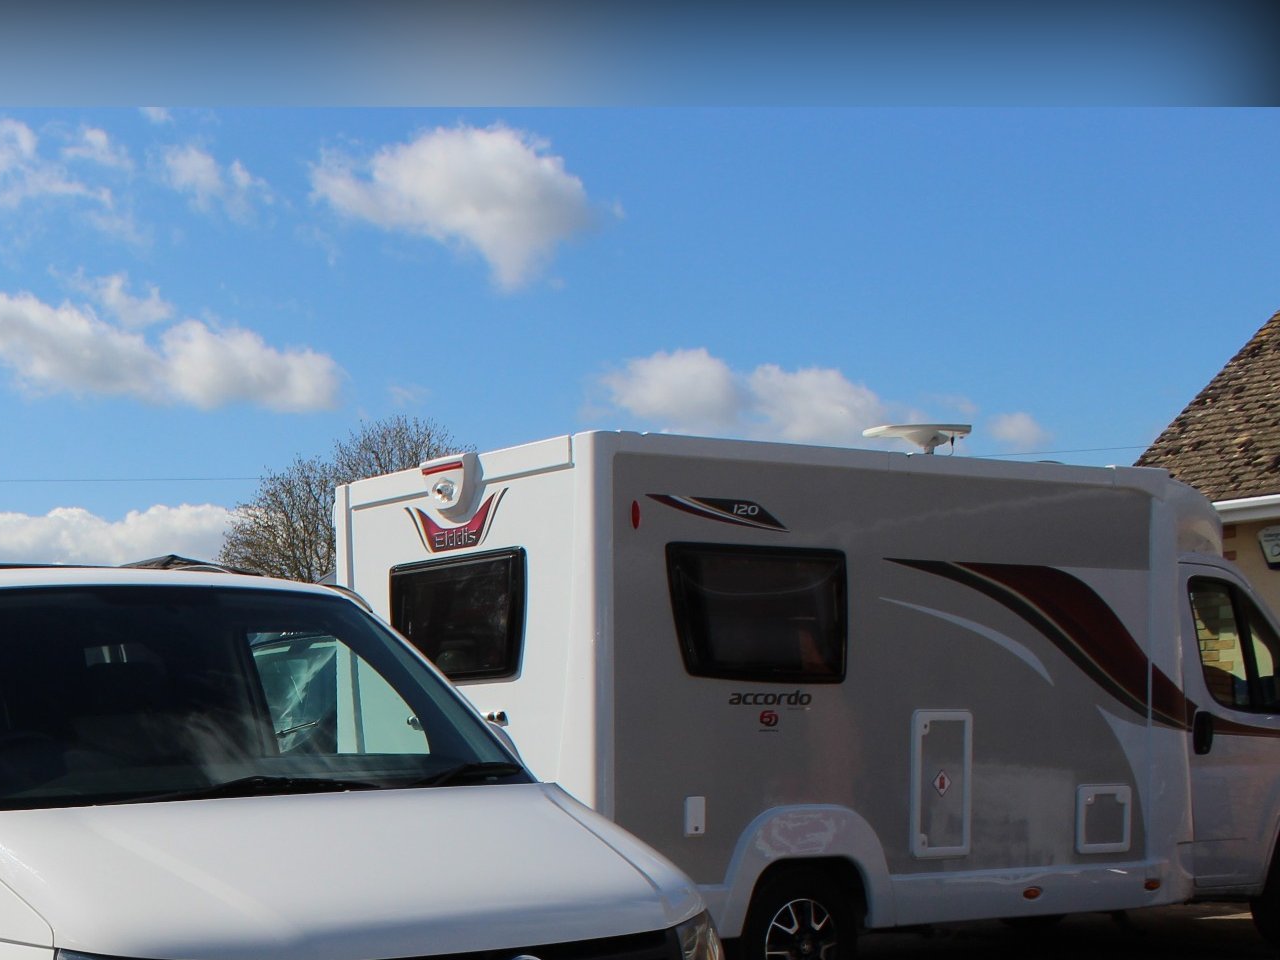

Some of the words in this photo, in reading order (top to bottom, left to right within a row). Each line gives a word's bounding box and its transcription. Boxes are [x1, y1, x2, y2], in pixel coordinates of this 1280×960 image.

[733, 504, 759, 516] 120
[433, 527, 477, 548] Elddis
[728, 690, 812, 705] accordo
